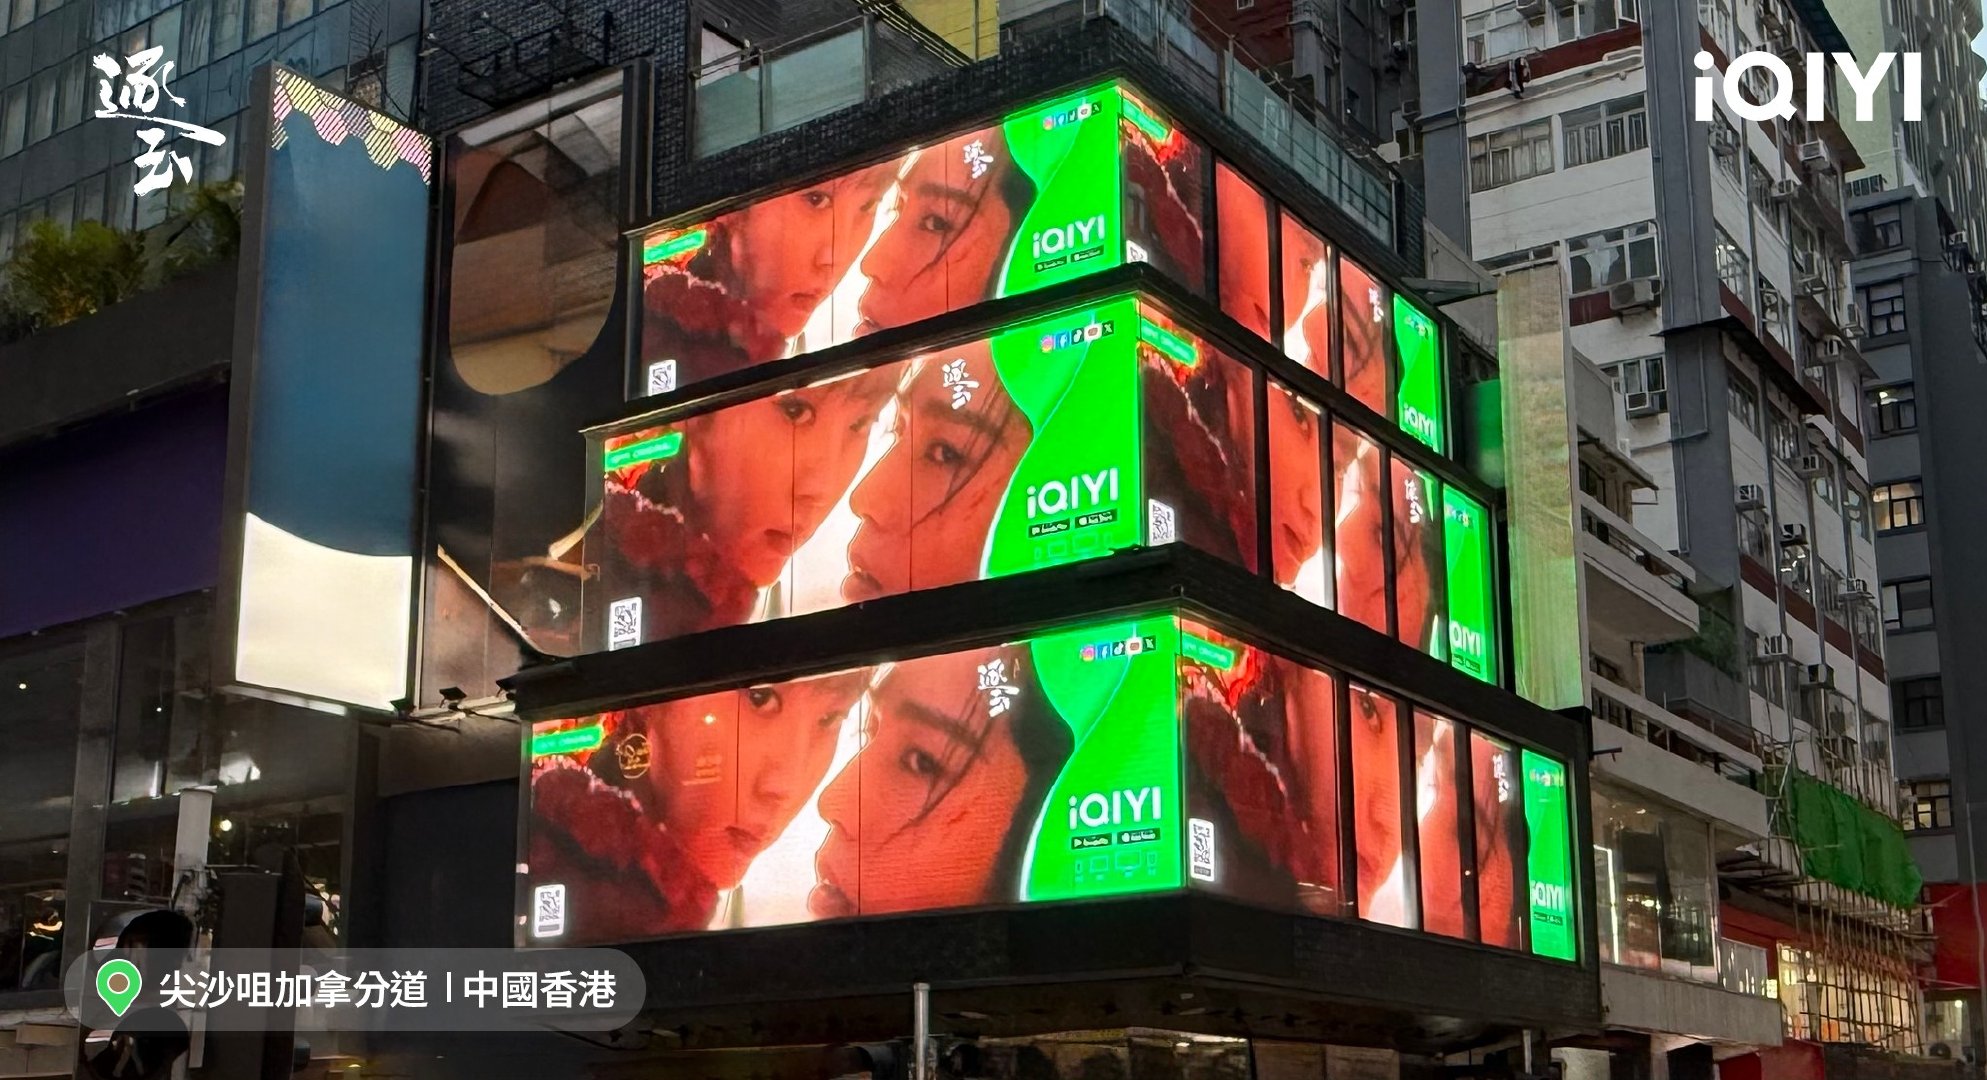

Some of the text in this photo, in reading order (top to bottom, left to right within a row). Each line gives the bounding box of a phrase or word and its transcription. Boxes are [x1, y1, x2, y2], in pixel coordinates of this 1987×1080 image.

[1032, 214, 1105, 259] iQIYI
[1027, 467, 1118, 519] iQIYI
[1069, 786, 1161, 830] iQIYI
